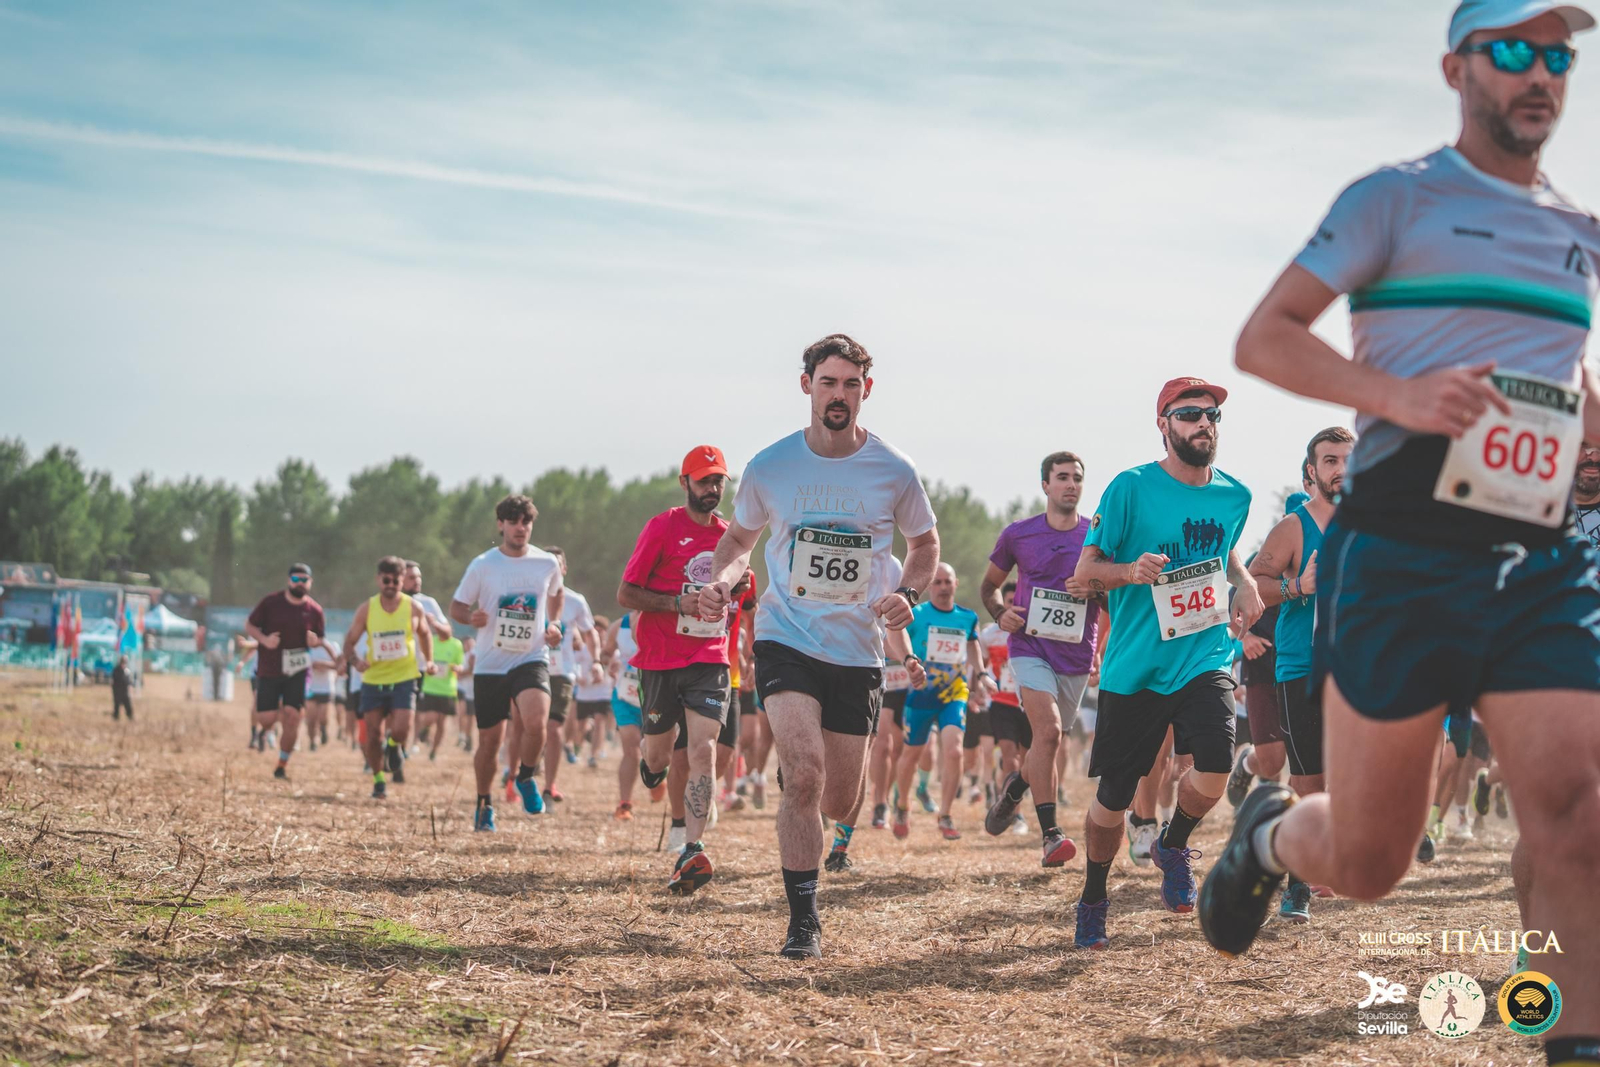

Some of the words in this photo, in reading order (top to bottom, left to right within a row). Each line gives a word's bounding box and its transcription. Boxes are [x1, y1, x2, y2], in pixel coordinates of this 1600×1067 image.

[1482, 425, 1560, 482] 603
[818, 533, 855, 546] ITÁLICA
[808, 554, 859, 582] 568
[1170, 586, 1216, 617] 548
[1041, 606, 1076, 627] 788
[498, 623, 532, 640] 1526
[936, 640, 960, 653] 754
